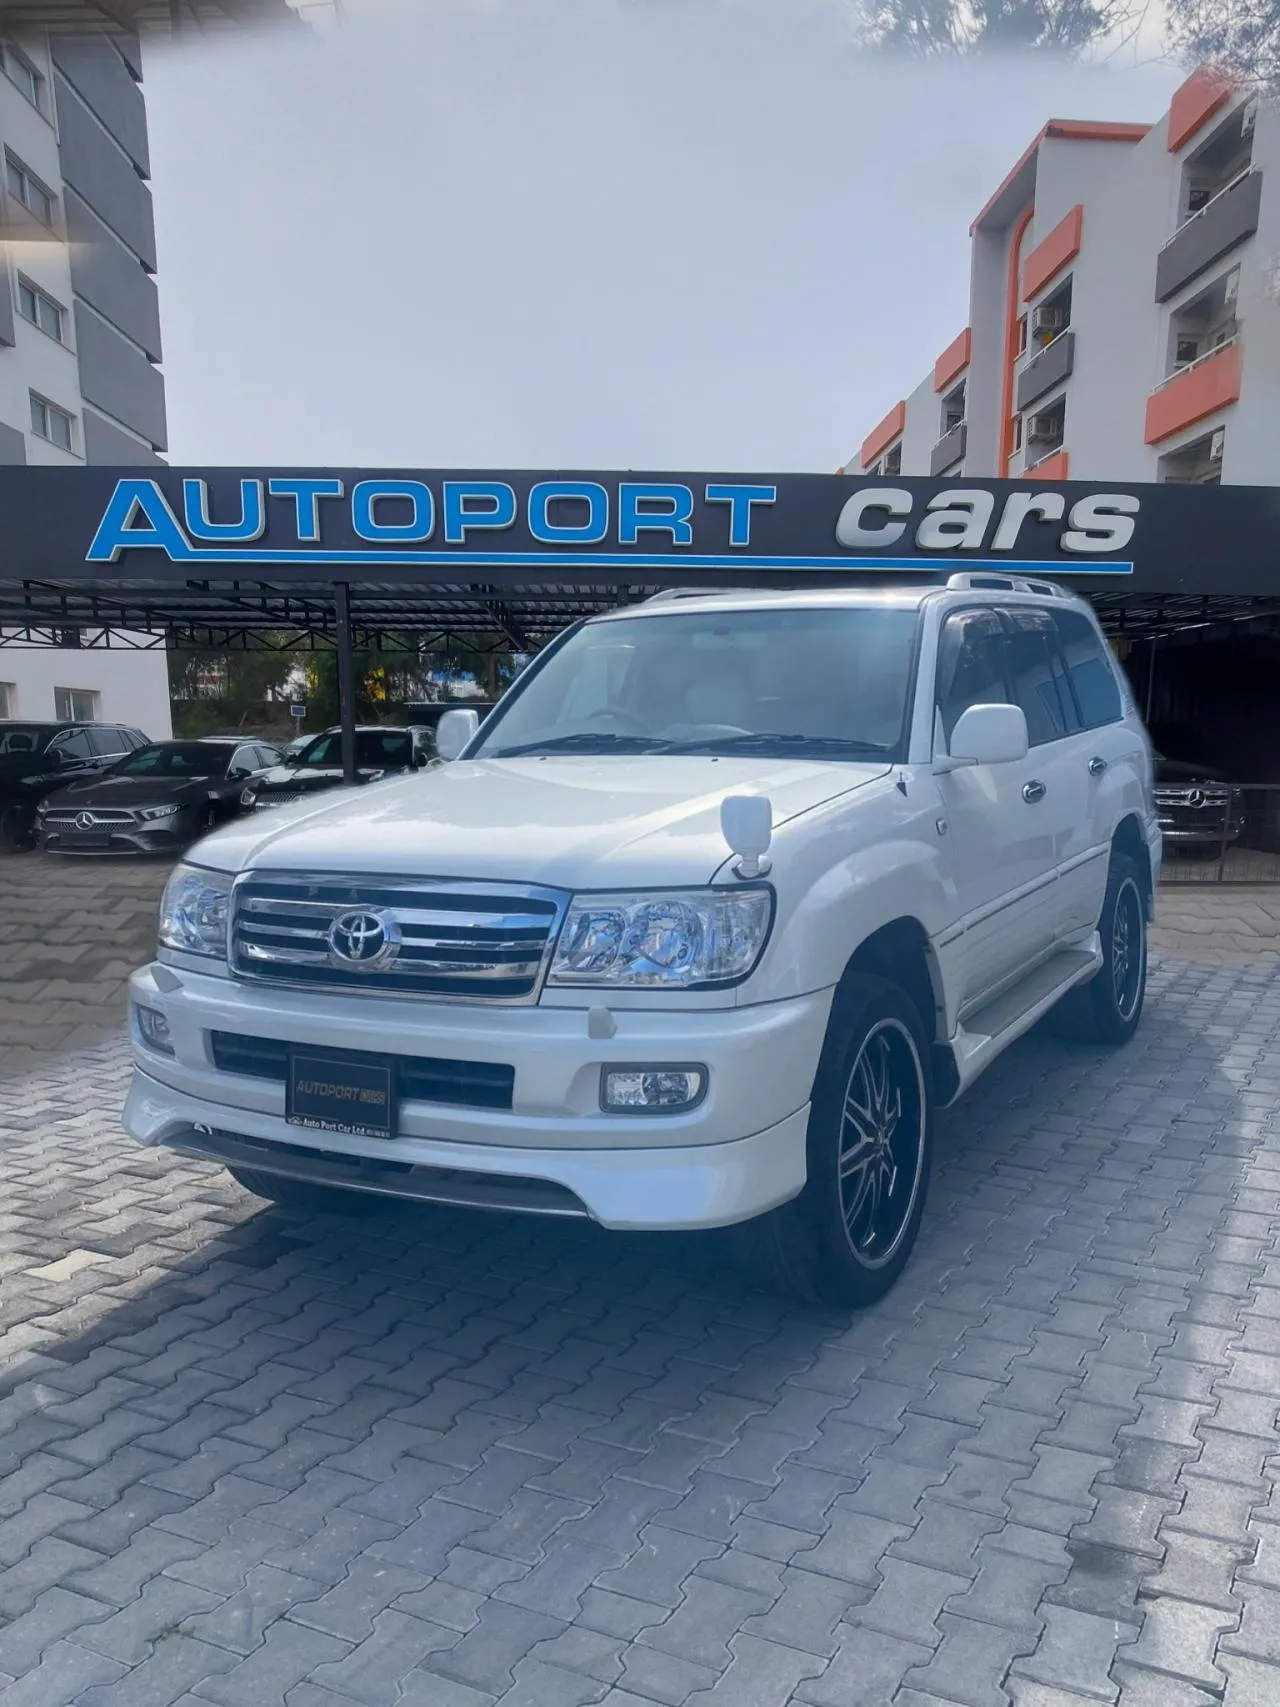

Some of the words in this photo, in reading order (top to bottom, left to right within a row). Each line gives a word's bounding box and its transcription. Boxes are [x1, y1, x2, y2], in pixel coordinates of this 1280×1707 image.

[85, 478, 777, 561] AUTOPORT
[836, 487, 1140, 553] cars
[296, 1080, 359, 1100] AUTOPORT
[303, 1118, 320, 1128] Auto
[321, 1121, 337, 1131] Port
[338, 1124, 351, 1133] Car
